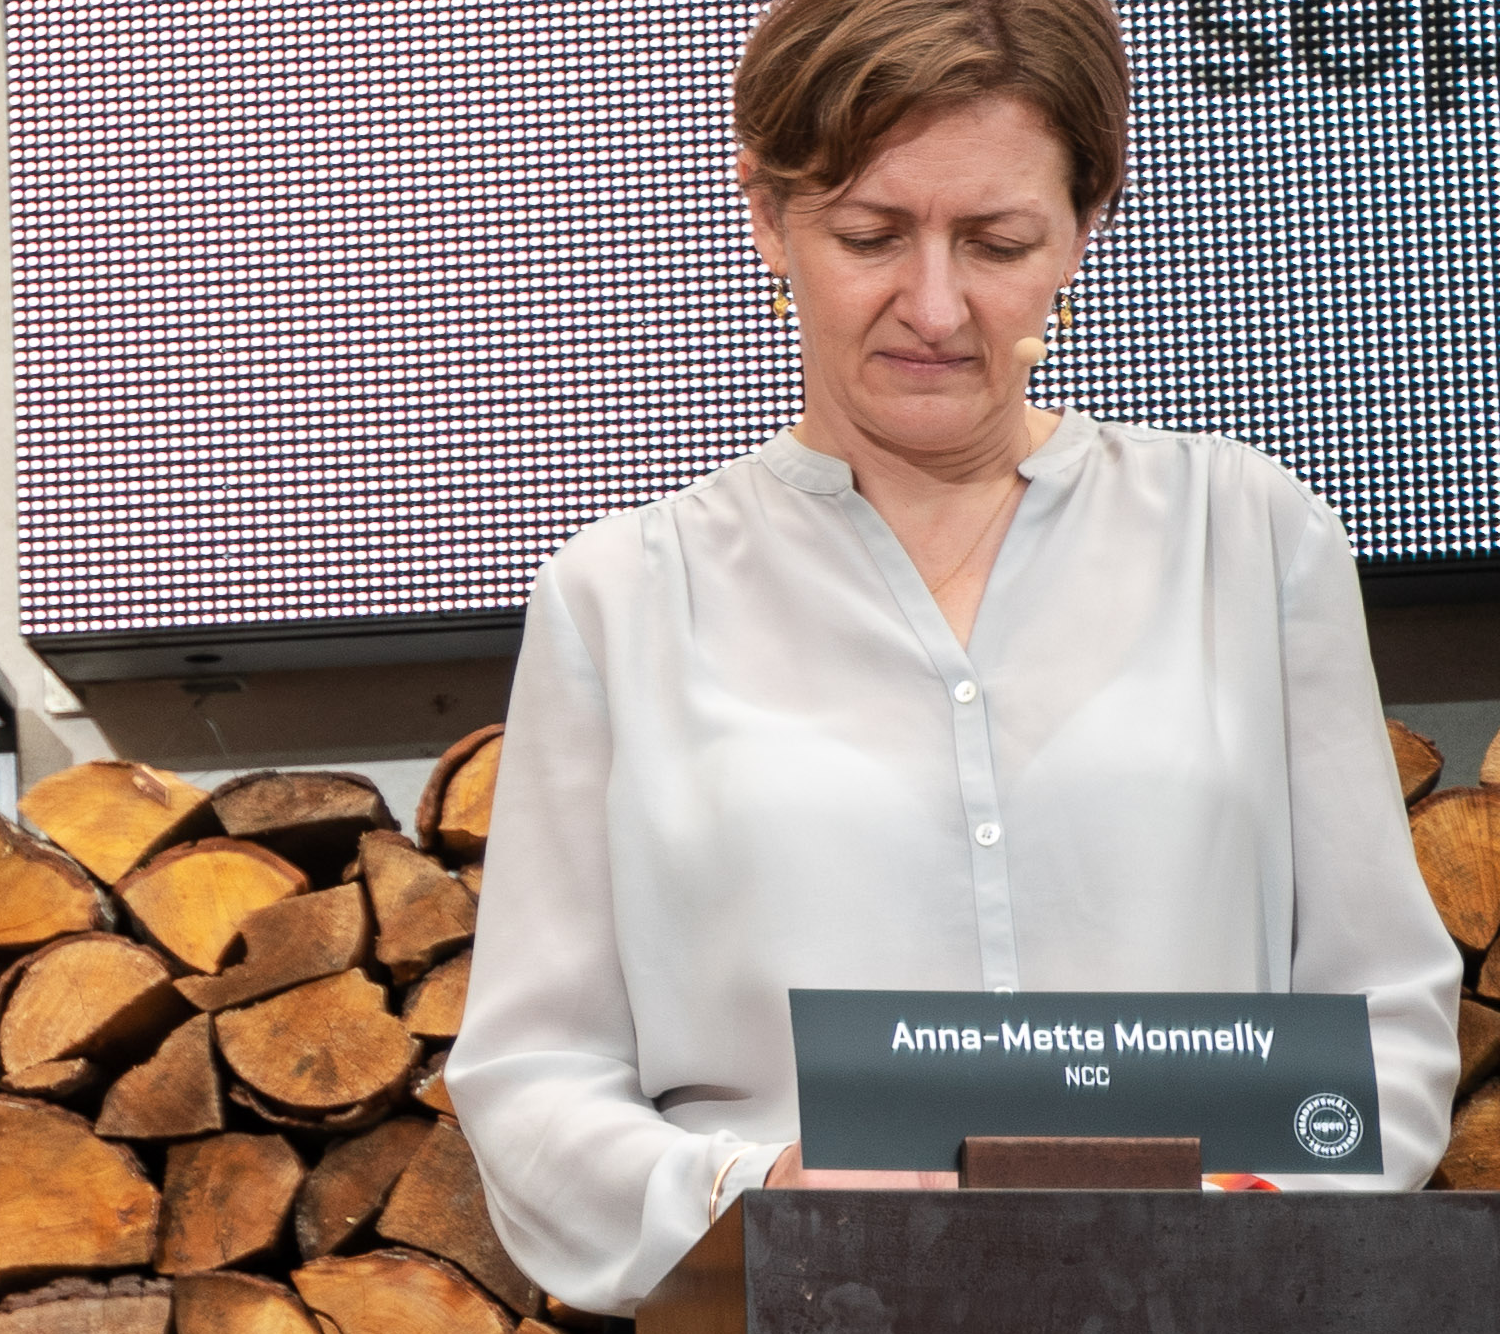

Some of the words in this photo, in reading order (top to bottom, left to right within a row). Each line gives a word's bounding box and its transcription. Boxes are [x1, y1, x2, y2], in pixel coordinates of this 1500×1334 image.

[891, 1020, 1105, 1052] Anna-Mette
[1114, 1020, 1274, 1060] Monnelly
[1065, 1066, 1111, 1086] NCC
